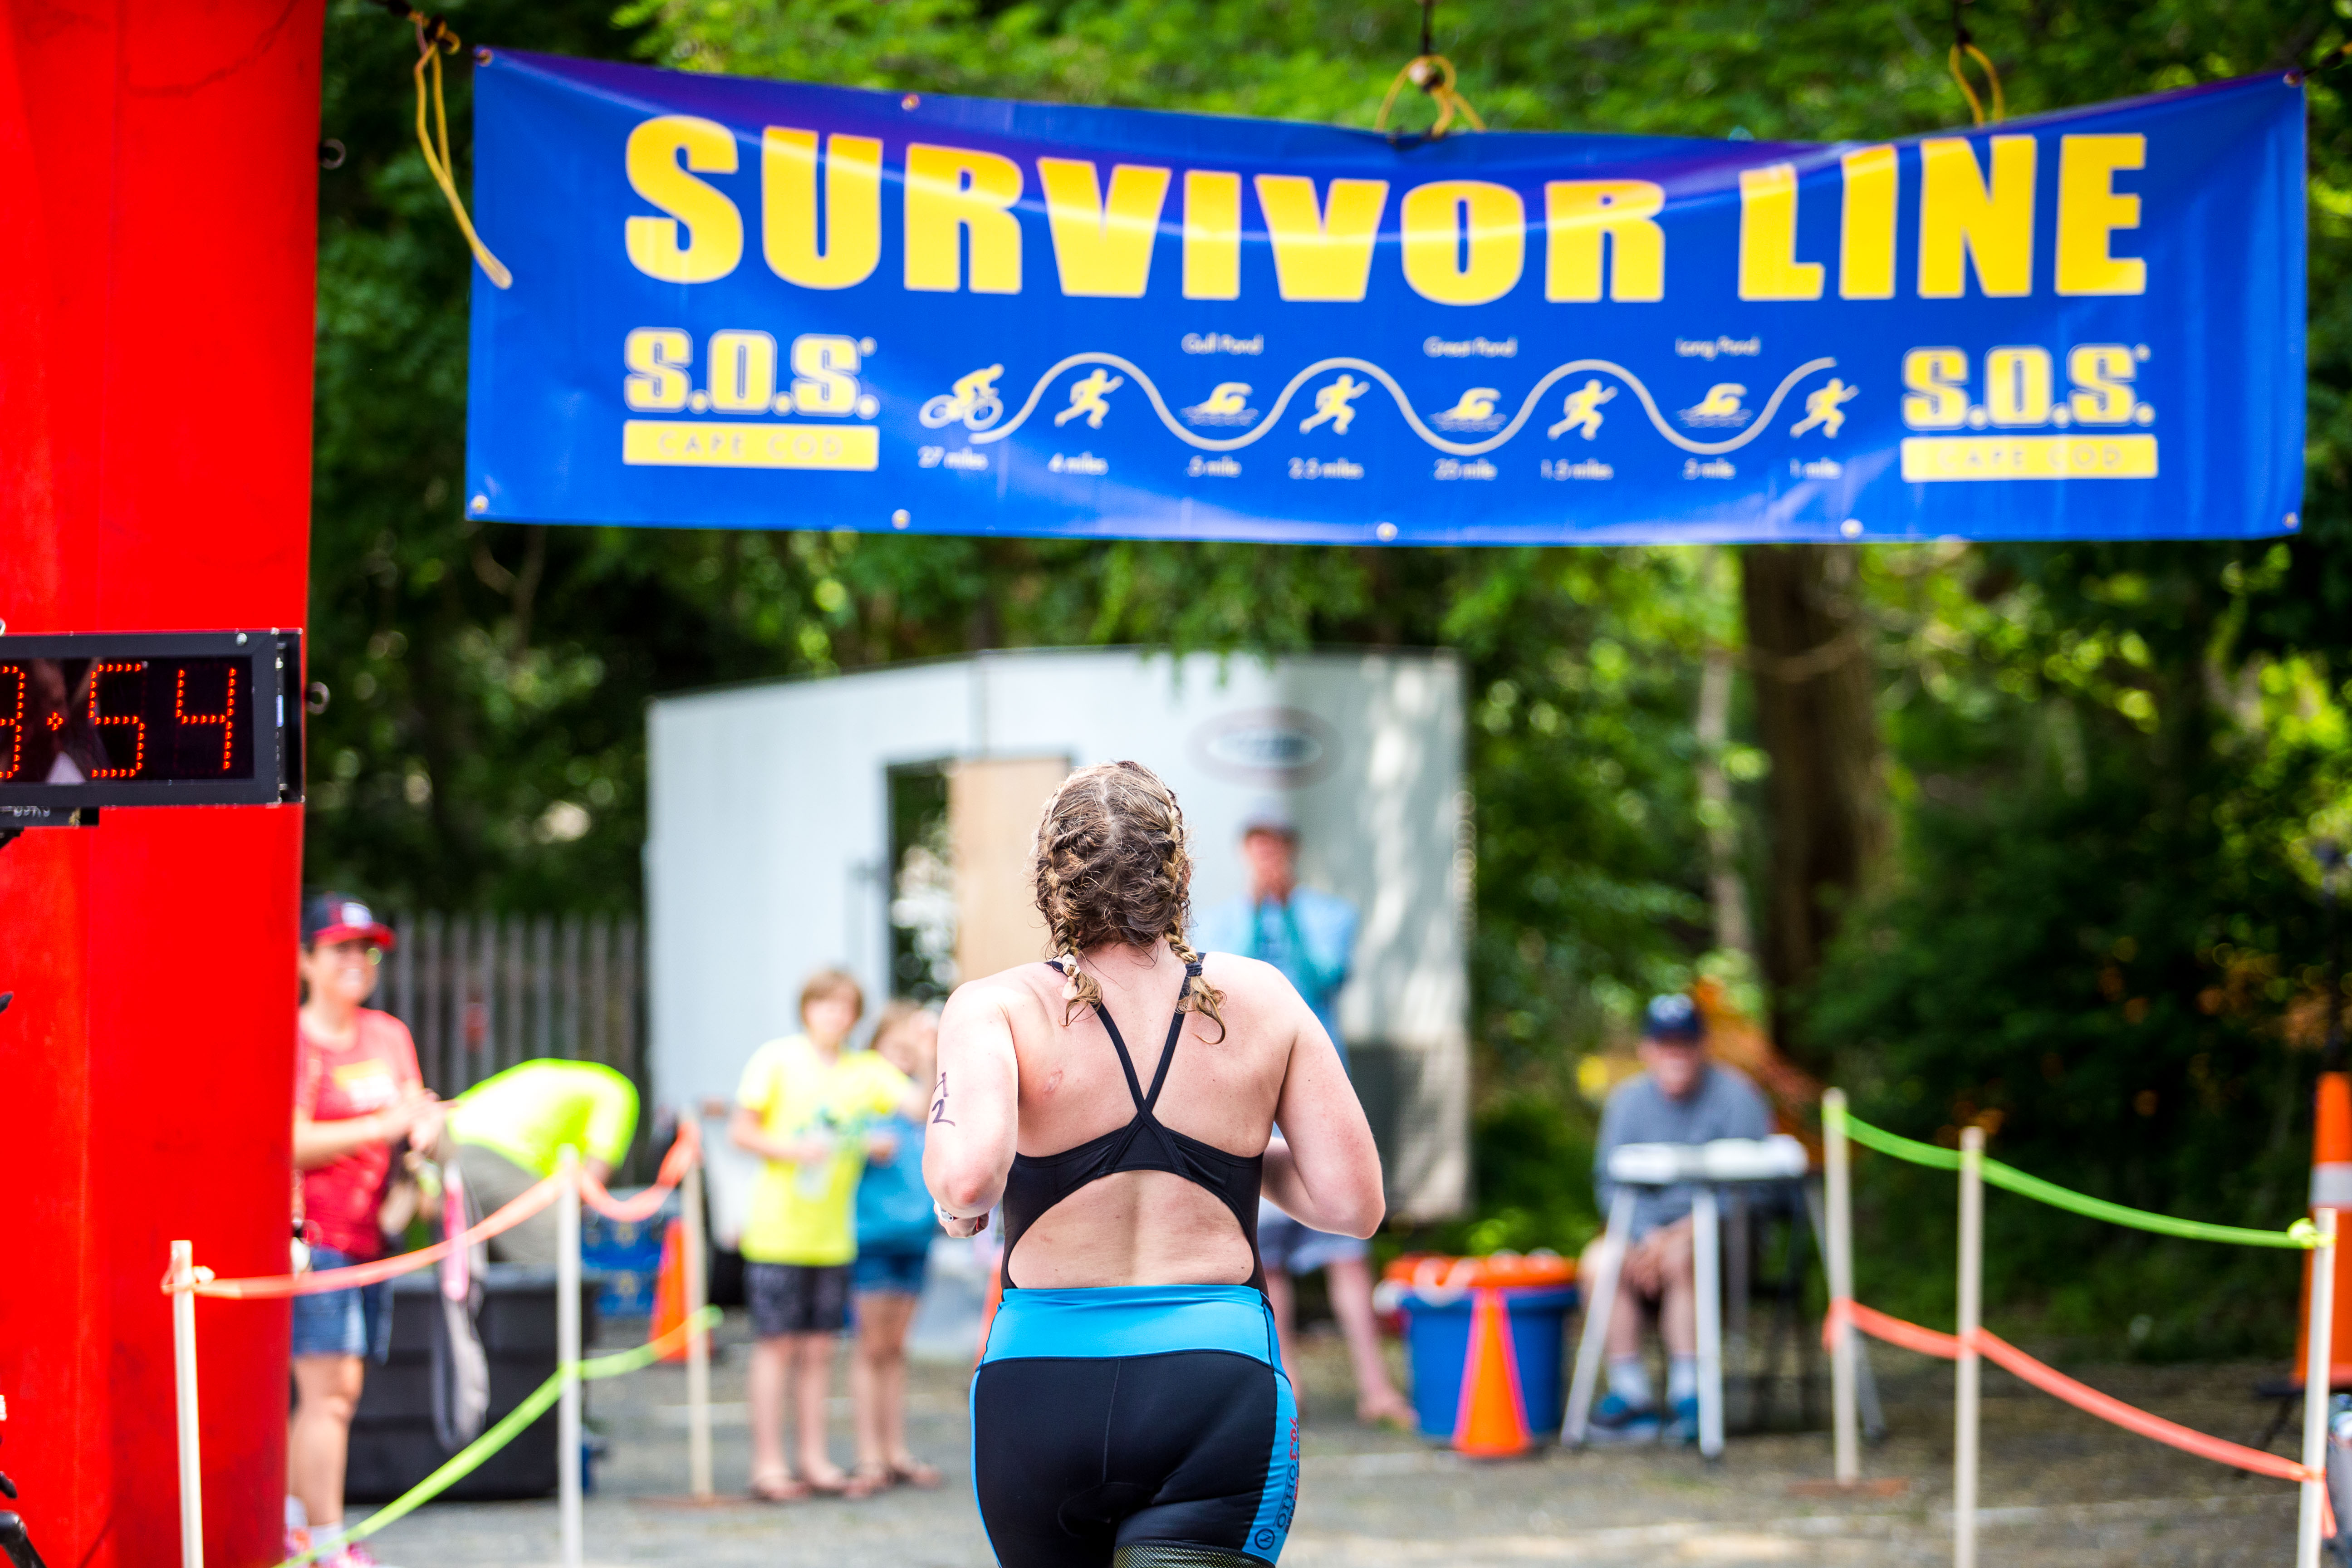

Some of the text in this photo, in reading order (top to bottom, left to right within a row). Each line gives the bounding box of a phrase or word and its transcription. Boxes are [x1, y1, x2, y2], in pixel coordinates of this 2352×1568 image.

[625, 115, 2147, 304] SURVIVOR LINE
[1220, 333, 1264, 356] Pond
[1423, 334, 1518, 358] Great Pond
[1675, 335, 1761, 361] Long Pond
[657, 429, 843, 461] CAPE COD
[917, 446, 989, 471] 27 miles
[1064, 451, 1109, 475] miles
[1204, 454, 1242, 478] mile
[1319, 456, 1365, 480] miles
[1461, 457, 1498, 481] mile
[1571, 457, 1614, 481] miles
[1700, 457, 1736, 480] mile
[1790, 456, 1843, 480] 1 mile
[1936, 443, 2124, 473] CAPE COD
[1277, 1464, 1297, 1529] OHIO
